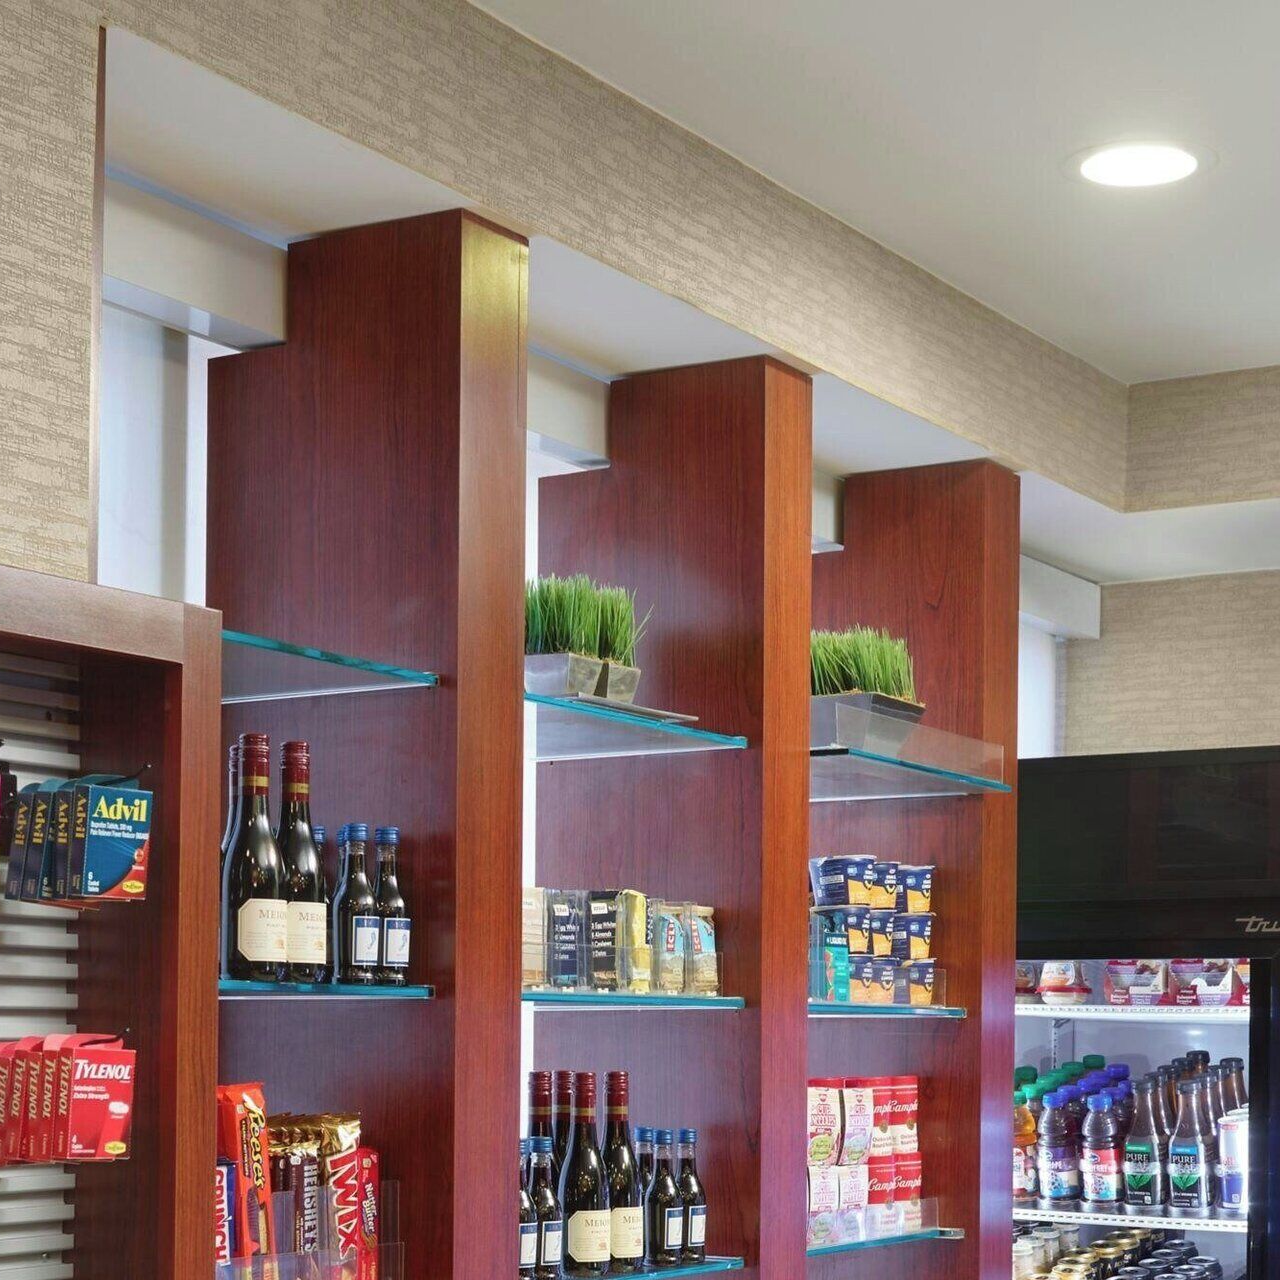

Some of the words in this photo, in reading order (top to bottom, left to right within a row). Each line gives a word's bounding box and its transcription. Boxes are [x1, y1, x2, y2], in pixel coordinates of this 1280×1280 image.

[14, 802, 28, 846] Advil
[32, 801, 47, 845] Advil
[56, 802, 70, 845] Advil
[74, 794, 87, 839] Advil
[92, 795, 148, 822] Advil
[11, 1058, 27, 1118] TYLENOL
[28, 1059, 41, 1121] TYLENOL
[42, 1056, 57, 1119] TYLENOL
[74, 1058, 132, 1083] TYLENOL
[241, 1092, 267, 1189] Reese's
[1125, 1152, 1148, 1162] PURE
[1172, 1154, 1195, 1163] PURE
[303, 1163, 319, 1254] HERSHEY'S
[326, 1146, 360, 1260] TWIX
[362, 1198, 376, 1233] Butter
[365, 1182, 378, 1216] Nutter
